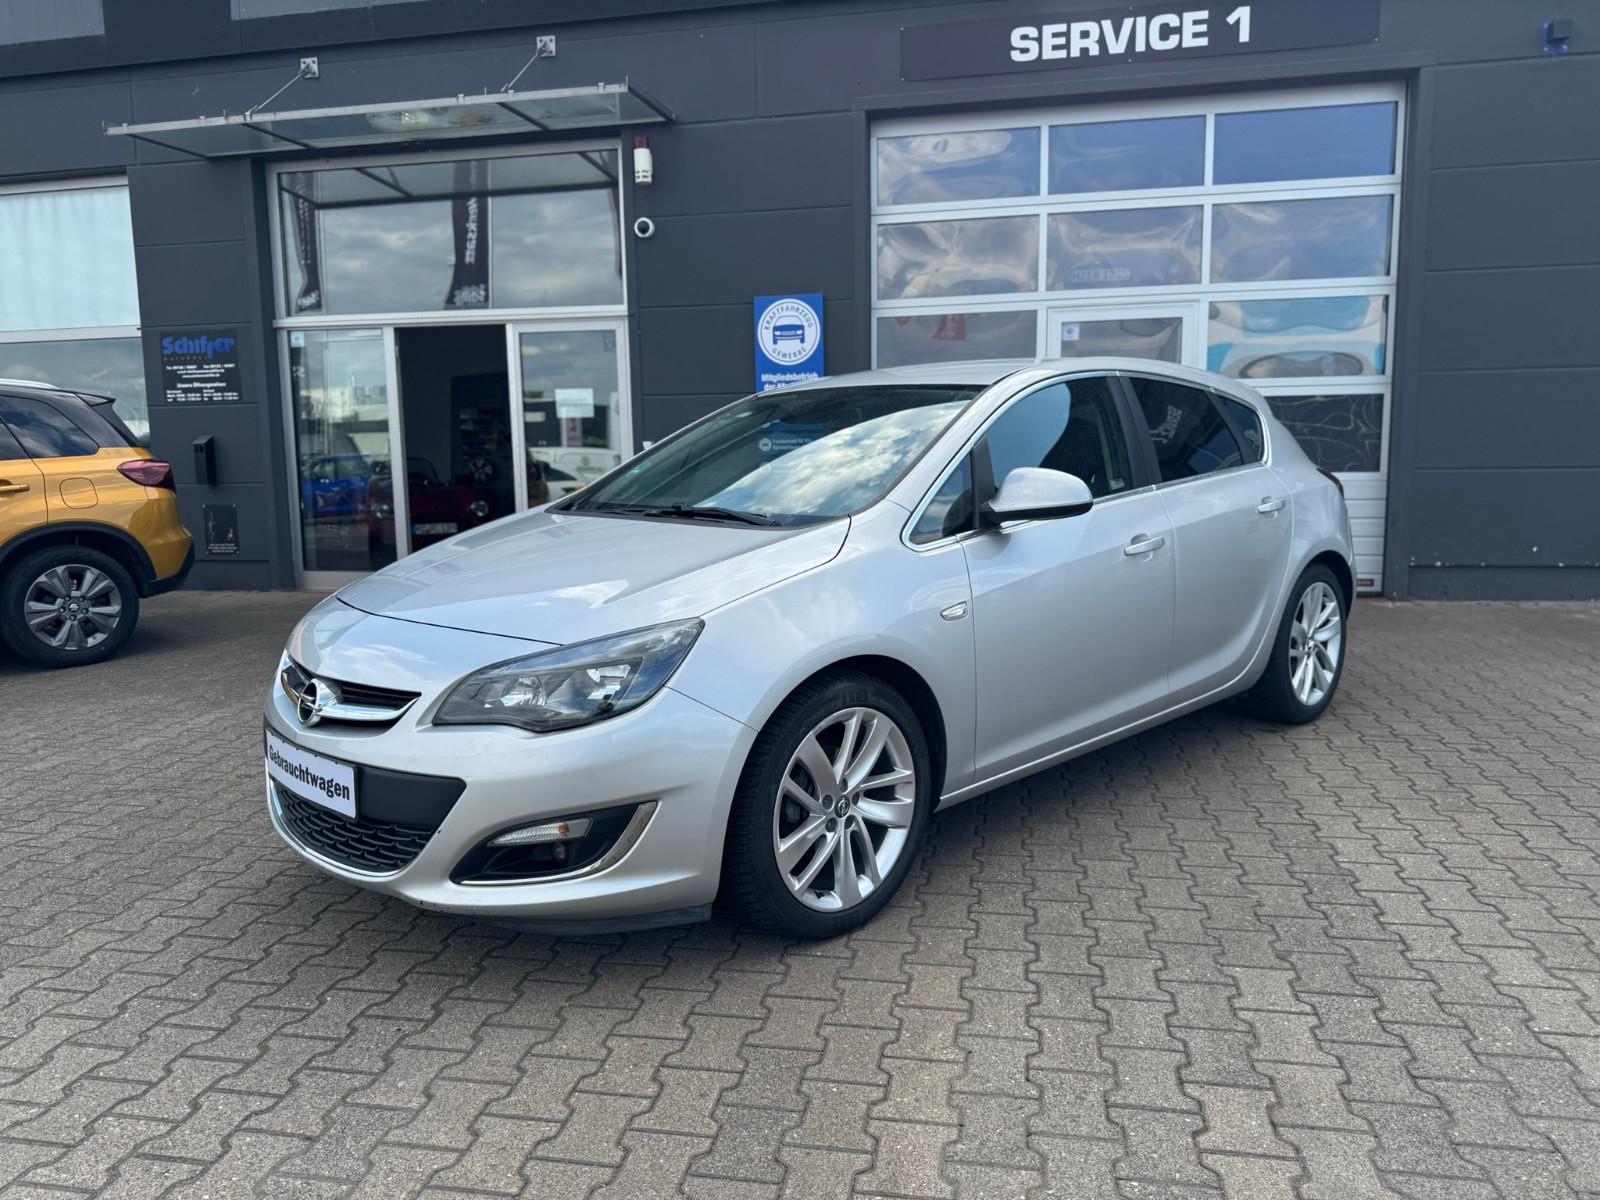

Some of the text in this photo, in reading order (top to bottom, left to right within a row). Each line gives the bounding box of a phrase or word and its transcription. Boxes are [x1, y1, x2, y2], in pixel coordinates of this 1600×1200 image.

[1010, 5, 1251, 62] SERVICE 1
[764, 304, 814, 330] KRAFTFAHRZEUG
[162, 335, 235, 359] Schiffer
[772, 346, 807, 360] GEWERBE
[761, 372, 819, 384] Mitgliedsbetrieb
[269, 744, 350, 801] Gebrauchtwagen
